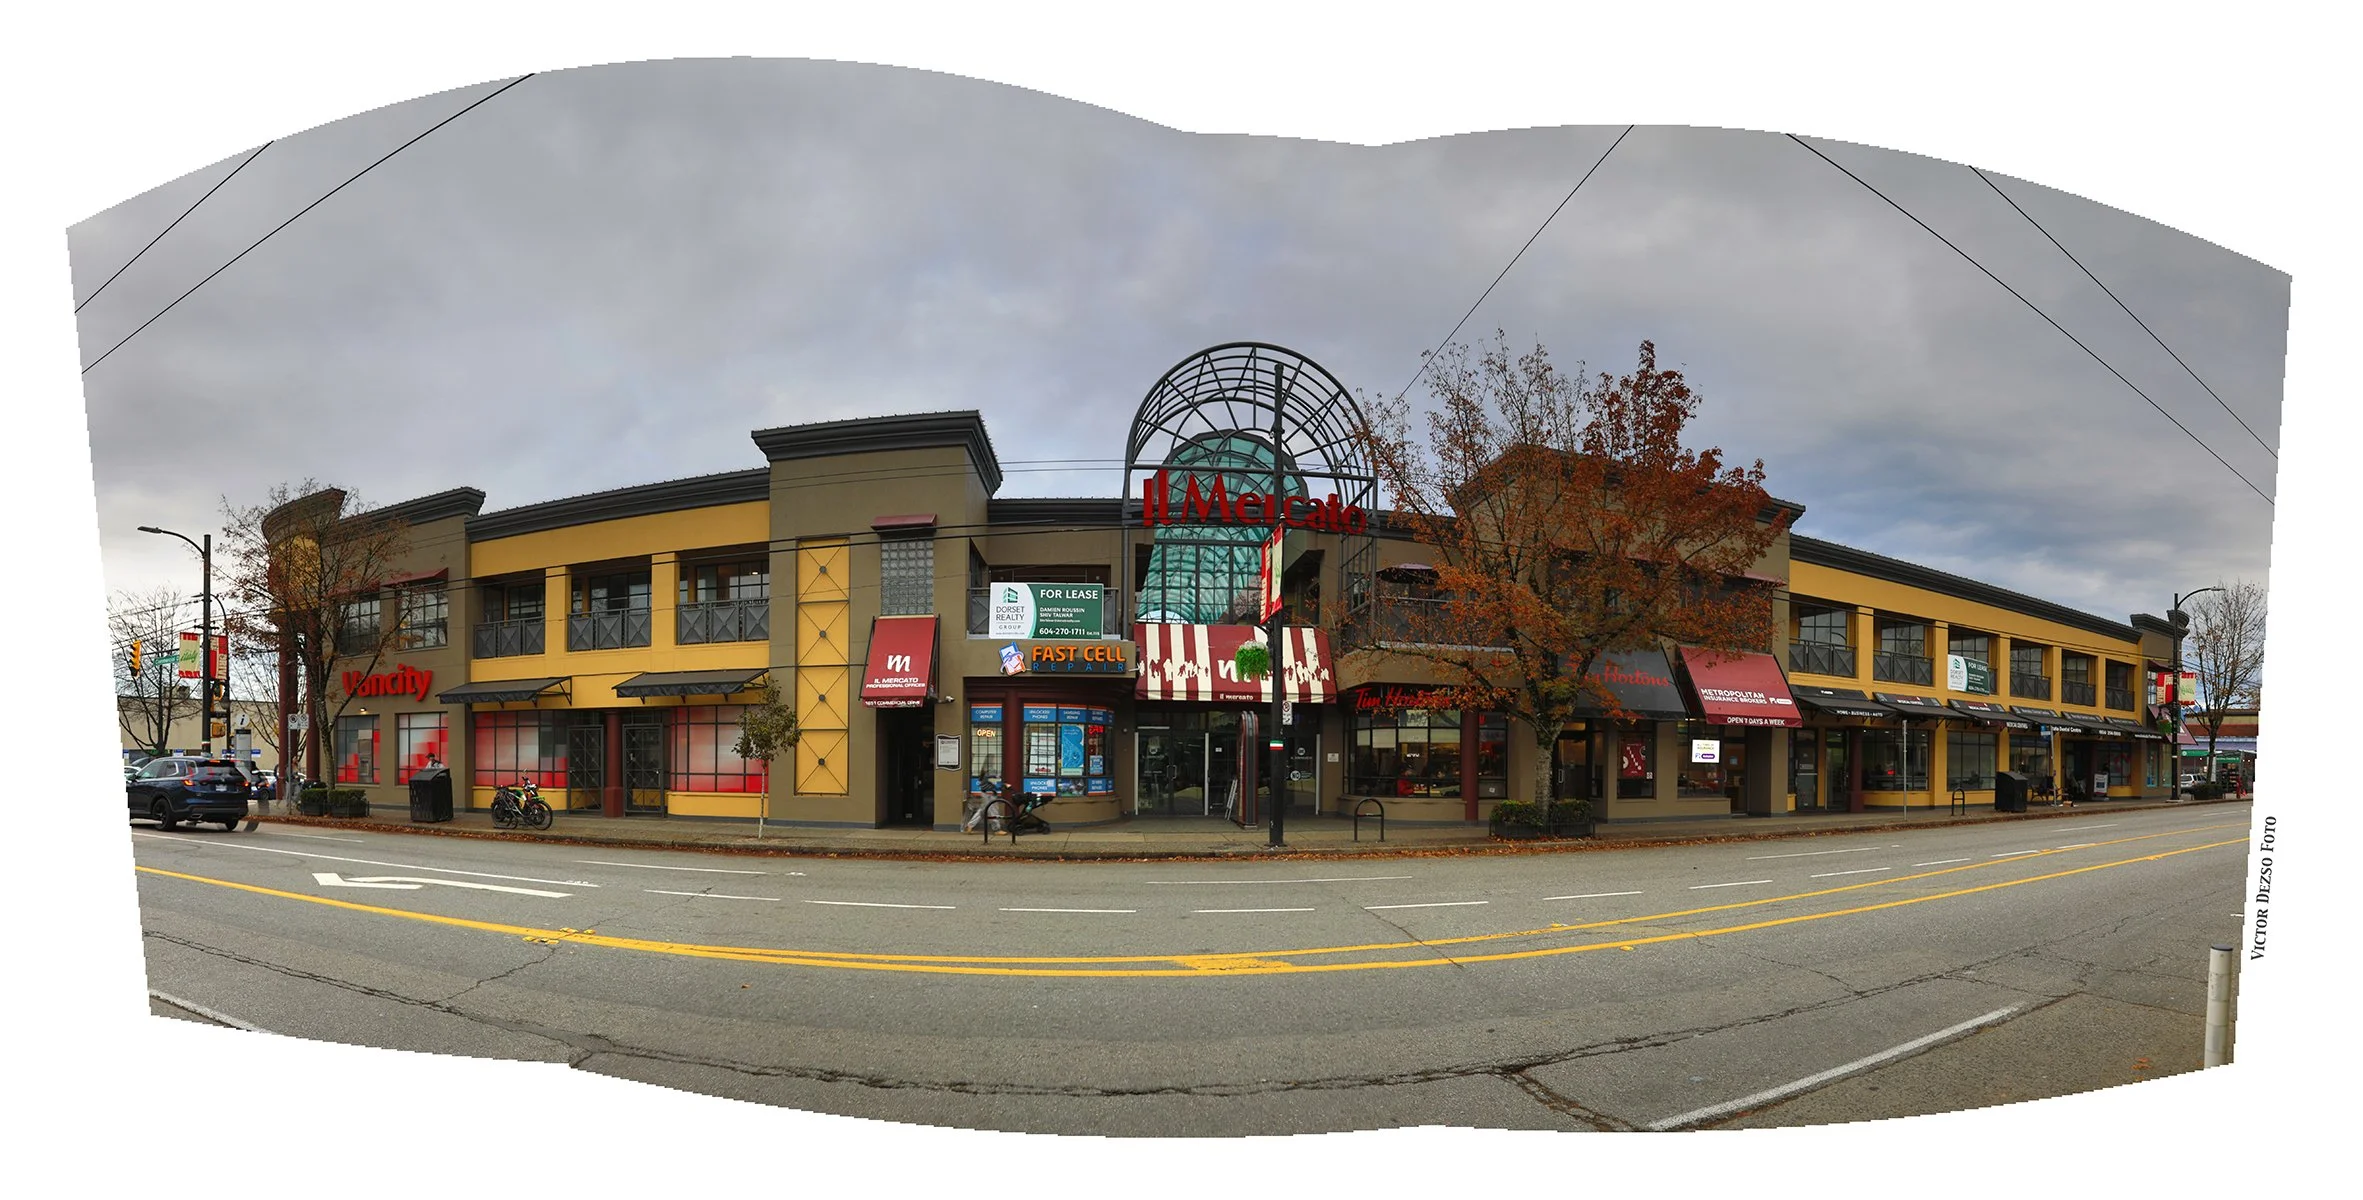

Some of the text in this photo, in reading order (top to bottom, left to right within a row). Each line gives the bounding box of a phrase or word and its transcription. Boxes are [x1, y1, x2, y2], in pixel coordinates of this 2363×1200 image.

[1181, 472, 1367, 534] Mercato
[1040, 589, 1098, 599] FOR LEASE
[1032, 646, 1126, 662] FAST CELL
[1033, 663, 1124, 672] REPAIR
[1604, 664, 1670, 687] Hortons
[342, 663, 433, 702] Vancity
[1355, 687, 1381, 709] Tim
[1701, 688, 1765, 699] METROPOLITAN
[976, 729, 997, 738] OPEN
